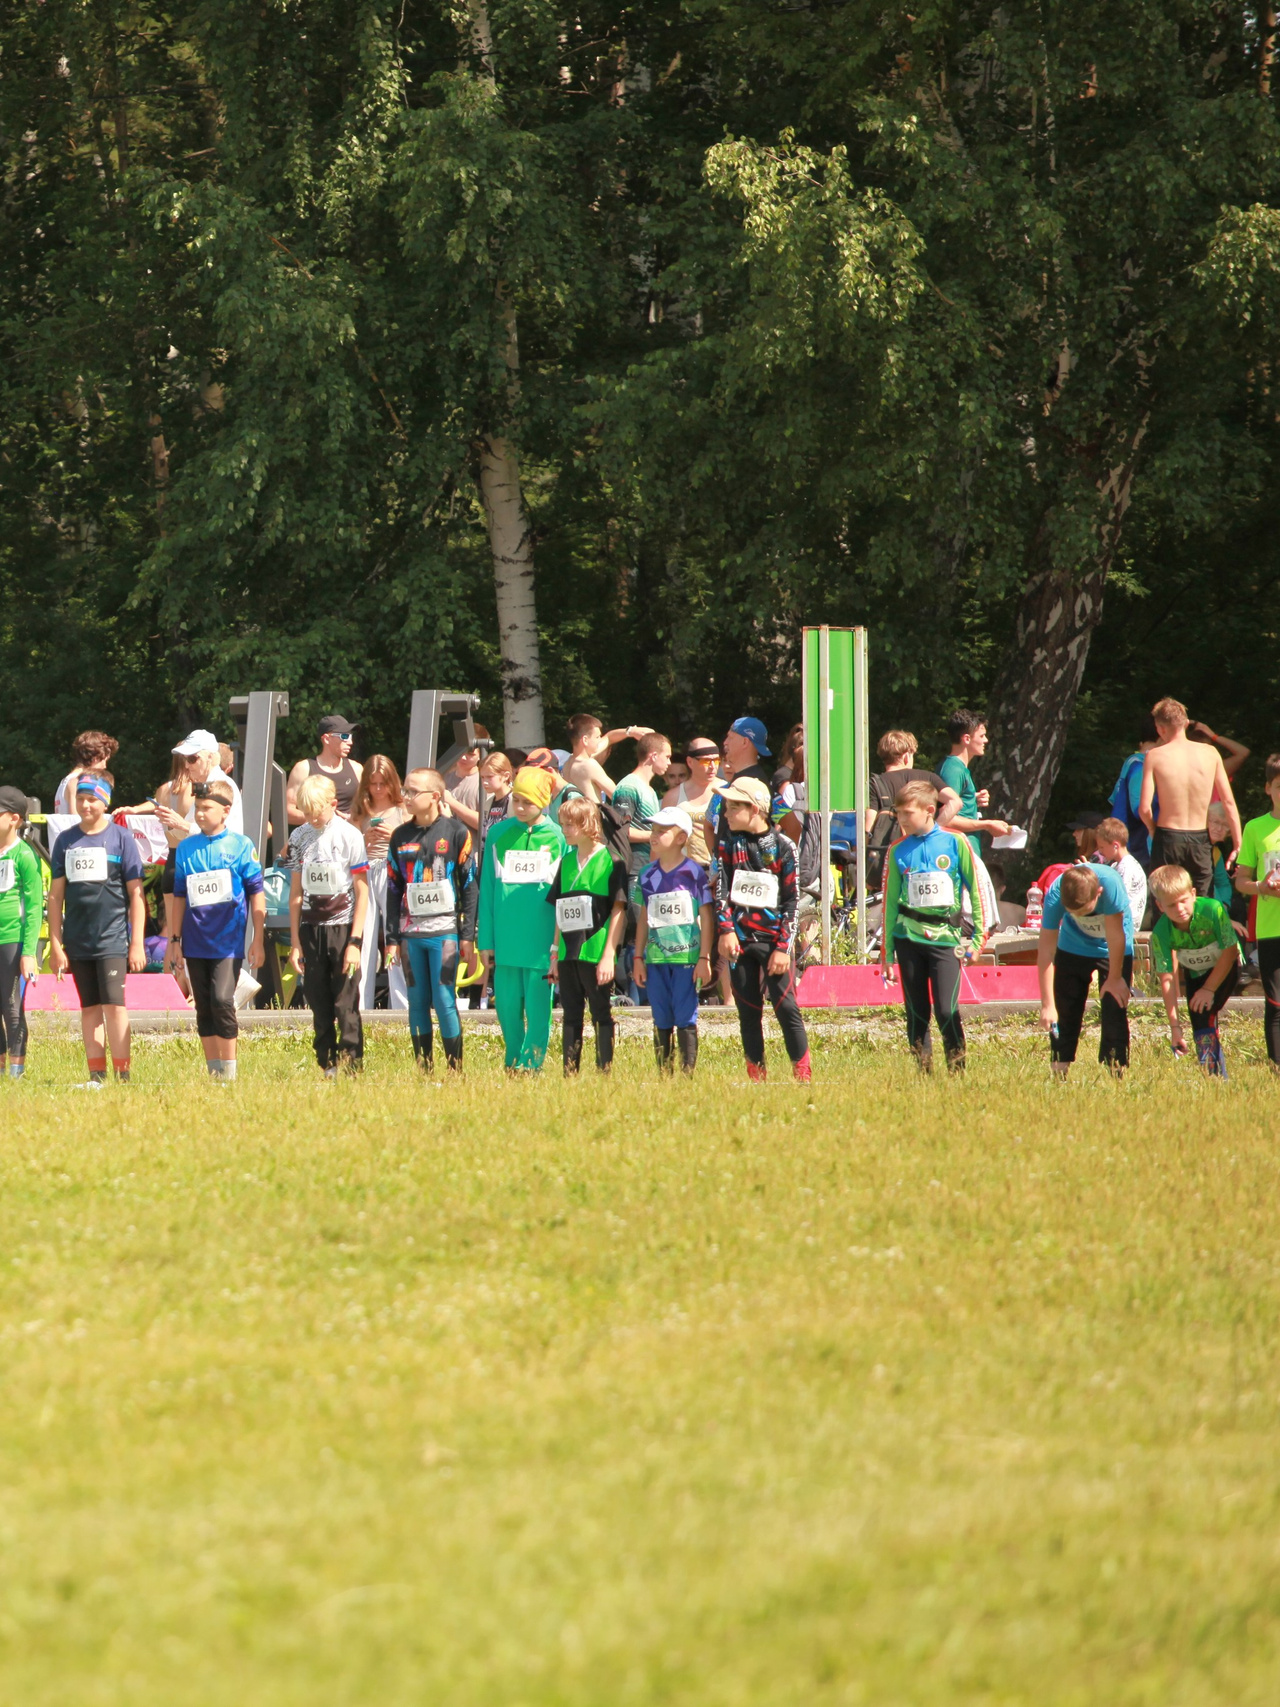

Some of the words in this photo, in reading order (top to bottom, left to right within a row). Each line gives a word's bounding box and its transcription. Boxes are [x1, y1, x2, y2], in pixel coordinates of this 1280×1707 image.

[75, 859, 95, 870] 632
[514, 862, 535, 873] 643
[310, 872, 329, 883] 641
[197, 882, 218, 895] 640
[740, 883, 763, 897] 646
[918, 883, 939, 896] 653
[417, 893, 440, 905] 644
[564, 907, 581, 919] 639
[660, 904, 681, 915] 645
[1188, 955, 1212, 965] 652
